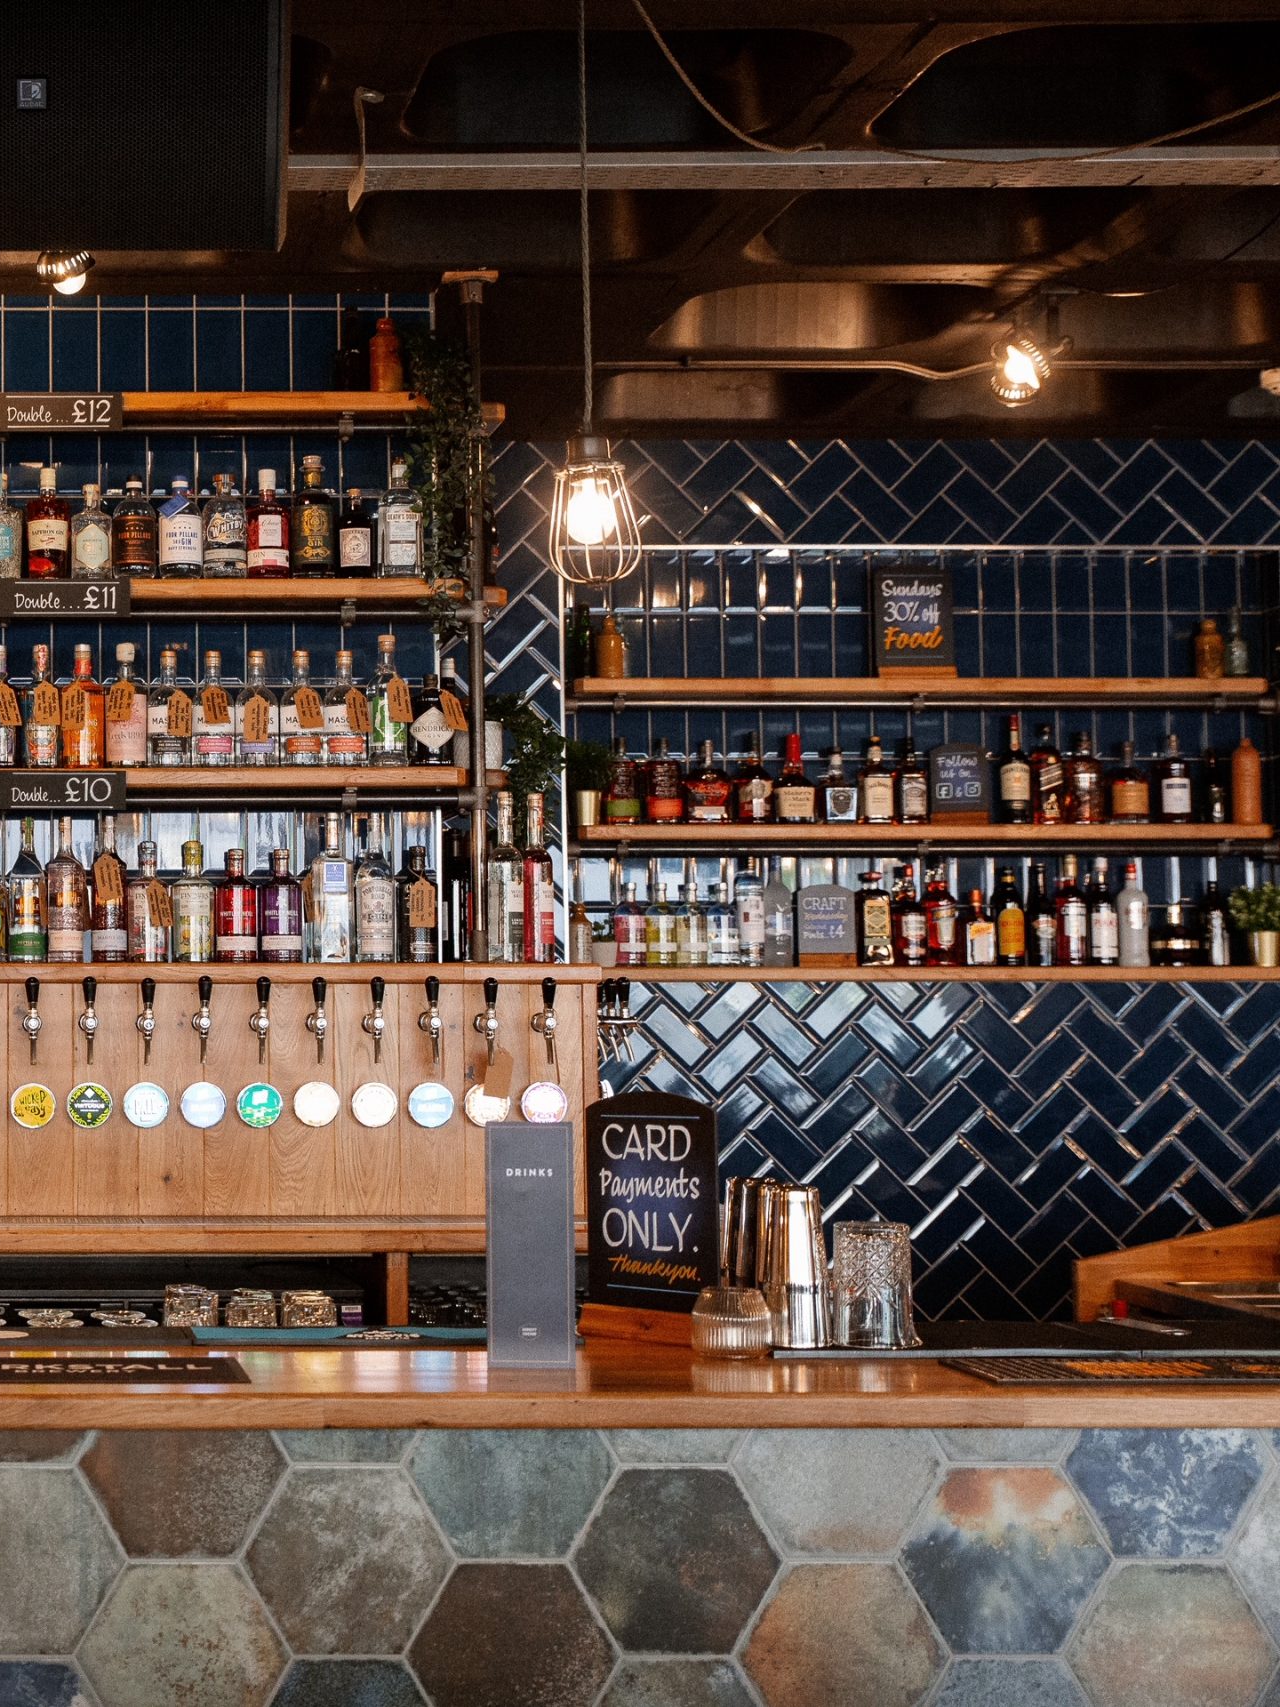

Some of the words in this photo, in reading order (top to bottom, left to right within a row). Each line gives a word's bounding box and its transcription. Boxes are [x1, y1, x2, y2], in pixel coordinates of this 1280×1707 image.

[72, 400, 112, 424] £12
[210, 520, 243, 537] WHITBY
[83, 586, 116, 610] £11
[881, 580, 944, 598] Sundays
[884, 601, 920, 622] 30%
[922, 603, 940, 624] off
[884, 624, 944, 650] Food
[936, 754, 978, 768] Follow
[64, 778, 112, 802] £10
[802, 896, 847, 910] CRAFT
[602, 1123, 692, 1162] CARD
[506, 1168, 554, 1177] DRINKS
[598, 1167, 700, 1204] Payments
[602, 1208, 699, 1253] ONLY.
